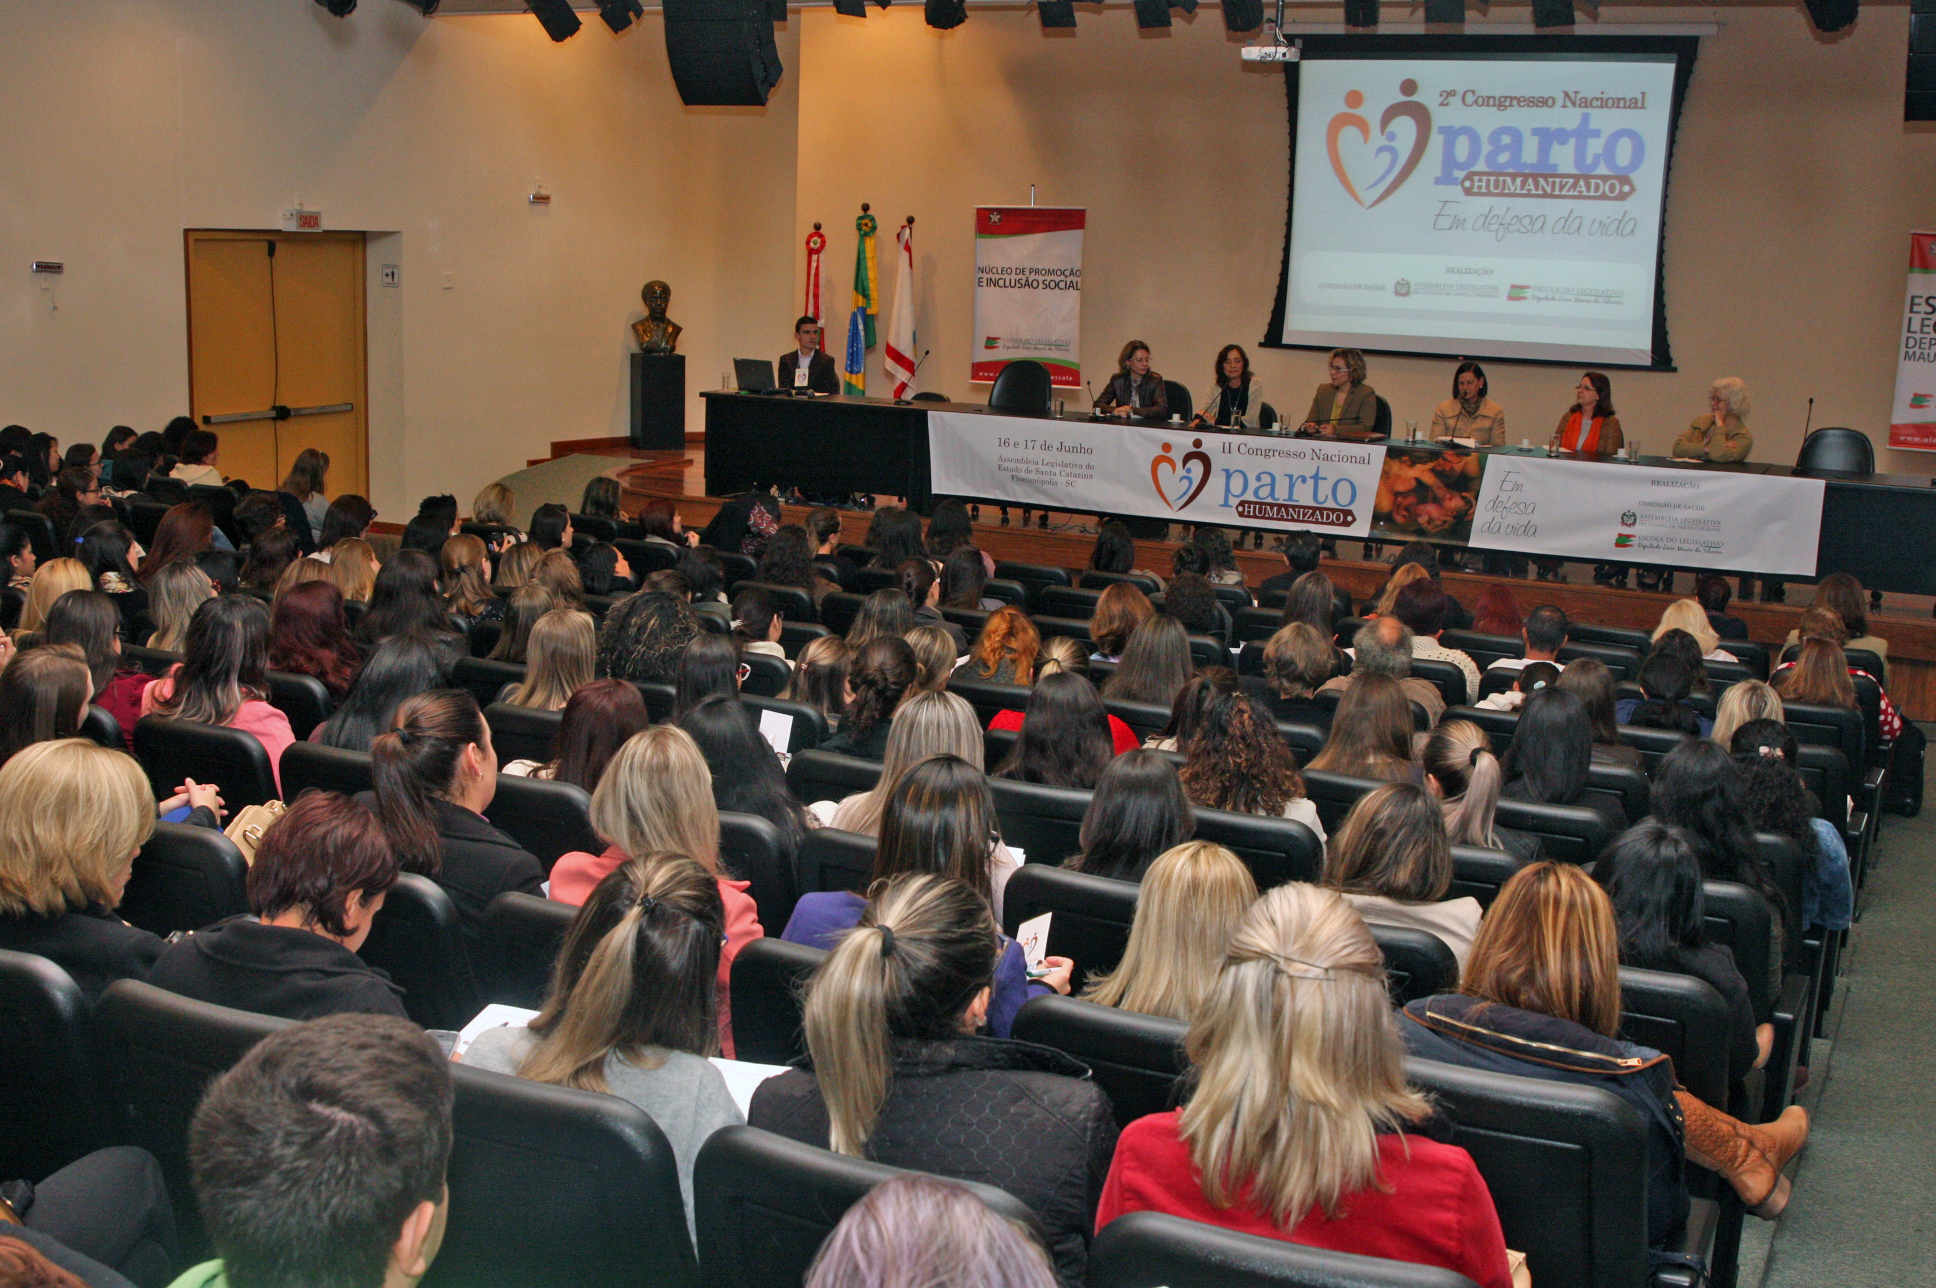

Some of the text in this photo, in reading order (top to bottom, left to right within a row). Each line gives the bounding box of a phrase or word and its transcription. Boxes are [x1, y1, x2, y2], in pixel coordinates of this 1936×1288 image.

[1461, 90, 1556, 111] Congresso
[1561, 91, 1647, 110] Nacional
[1434, 112, 1645, 186] parto
[1472, 175, 1620, 197] HUMANIZADO
[1432, 200, 1637, 242] Em defesa da vida
[977, 265, 1081, 279] NÚCLEO DE PROMOÇÃO
[978, 277, 1080, 290] E INCLUSÃO SOCIAL
[1906, 316, 1936, 334] LE
[997, 438, 1010, 448] 16
[1024, 440, 1037, 450] 17
[1040, 440, 1053, 451] de
[1056, 441, 1093, 455] Junho
[1221, 442, 1371, 465] II Congresso Nacional
[997, 455, 1039, 466] Assembleia
[1041, 459, 1083, 470] Legislativa
[998, 464, 1093, 479] Estado de Santa Catarina
[1011, 475, 1058, 487] Florianópolis
[1219, 465, 1357, 508] parto
[1500, 471, 1523, 493] Em
[1651, 480, 1699, 490] REALIZAÇÃO
[1244, 504, 1343, 524] HUMANIZADO
[1485, 495, 1536, 519] defesa
[1639, 501, 1671, 509] COMISSÃO
[1481, 516, 1537, 538] da vida
[1640, 514, 1721, 526] ASSEMBLEIA LEGISLATIVA
[1638, 535, 1664, 543] ESCOLA
[1680, 538, 1724, 547] LEGISLATIVO
